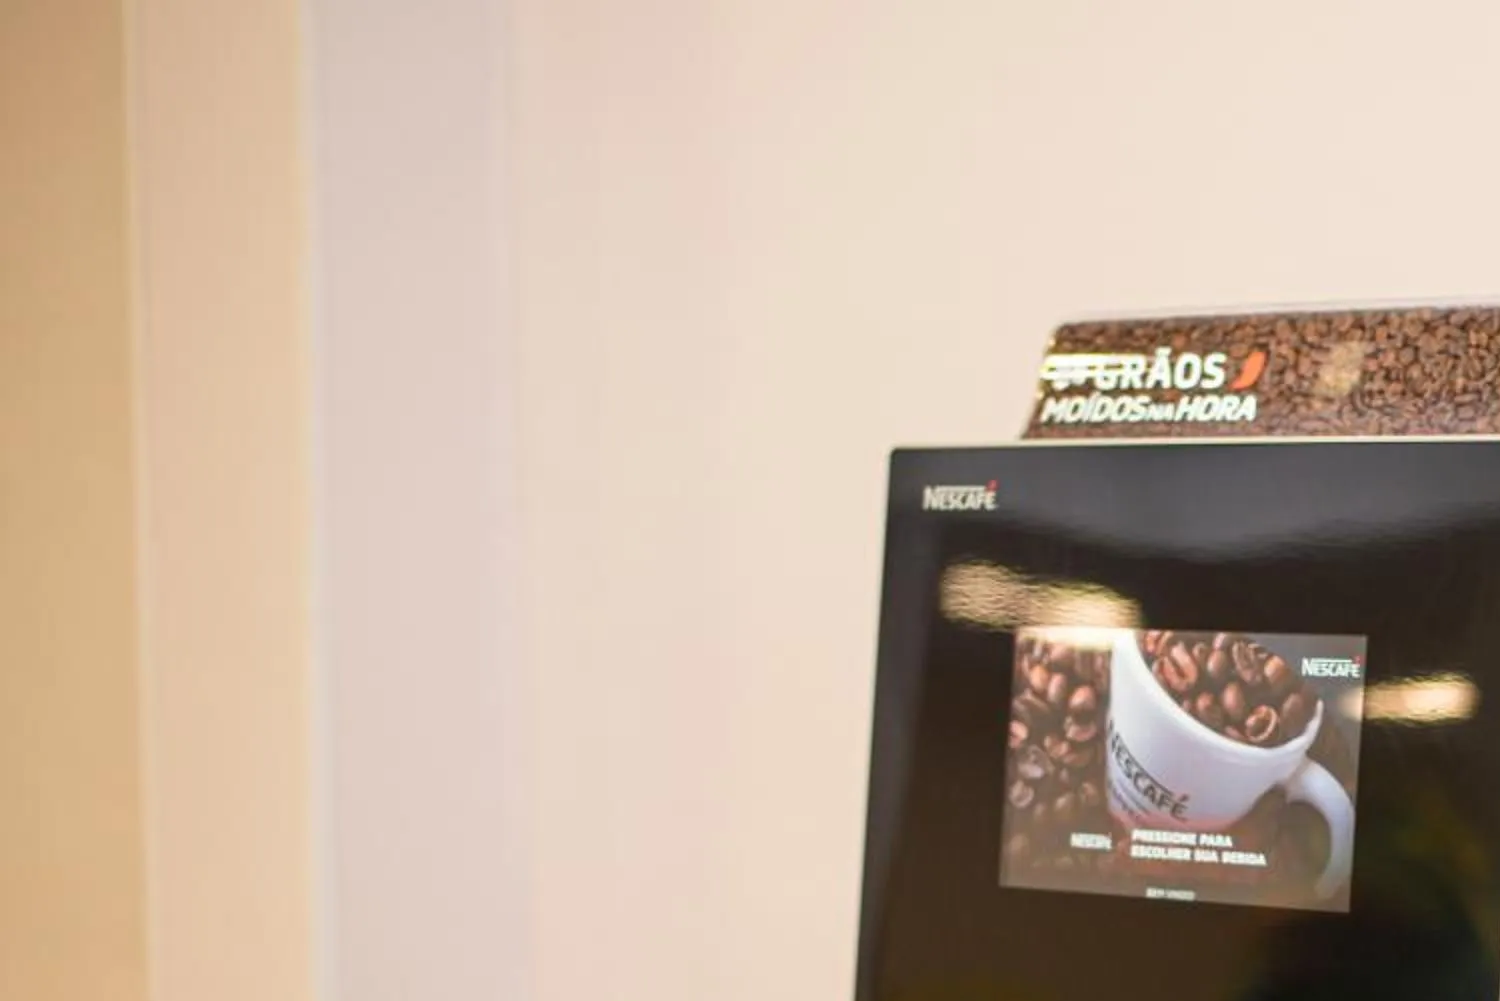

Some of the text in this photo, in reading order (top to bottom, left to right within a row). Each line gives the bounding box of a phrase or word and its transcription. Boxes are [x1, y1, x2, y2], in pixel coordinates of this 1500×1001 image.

[1093, 347, 1227, 391] GRÃOS
[1041, 391, 1151, 423] MOÍDOS
[1175, 394, 1257, 422] HORA
[922, 480, 999, 512] NESCAFÉ
[1301, 655, 1364, 678] NESCAFÉ
[1199, 833, 1233, 848] PARA
